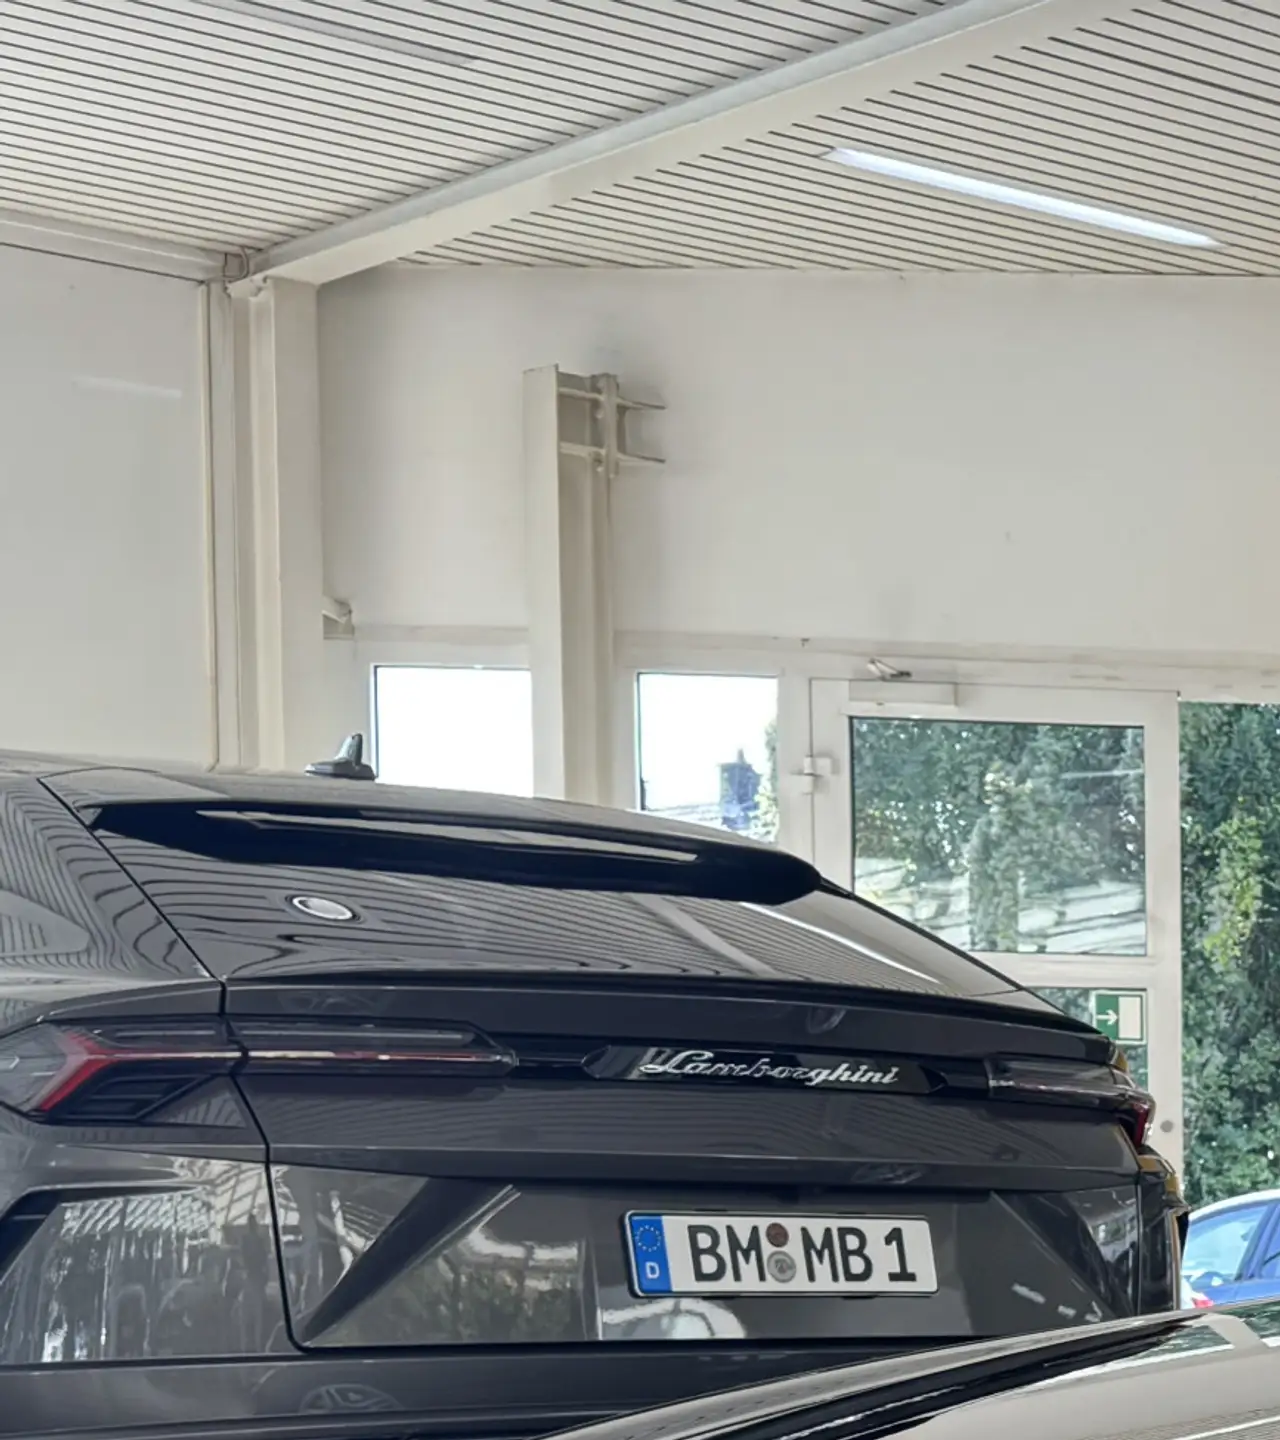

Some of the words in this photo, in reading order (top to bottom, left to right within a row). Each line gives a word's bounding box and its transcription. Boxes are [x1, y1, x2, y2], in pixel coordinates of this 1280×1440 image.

[640, 1050, 900, 1086] Lamborghini
[645, 1261, 660, 1279] D
[687, 1224, 767, 1283] BM
[800, 1226, 873, 1283] MB
[884, 1227, 917, 1282] 1
